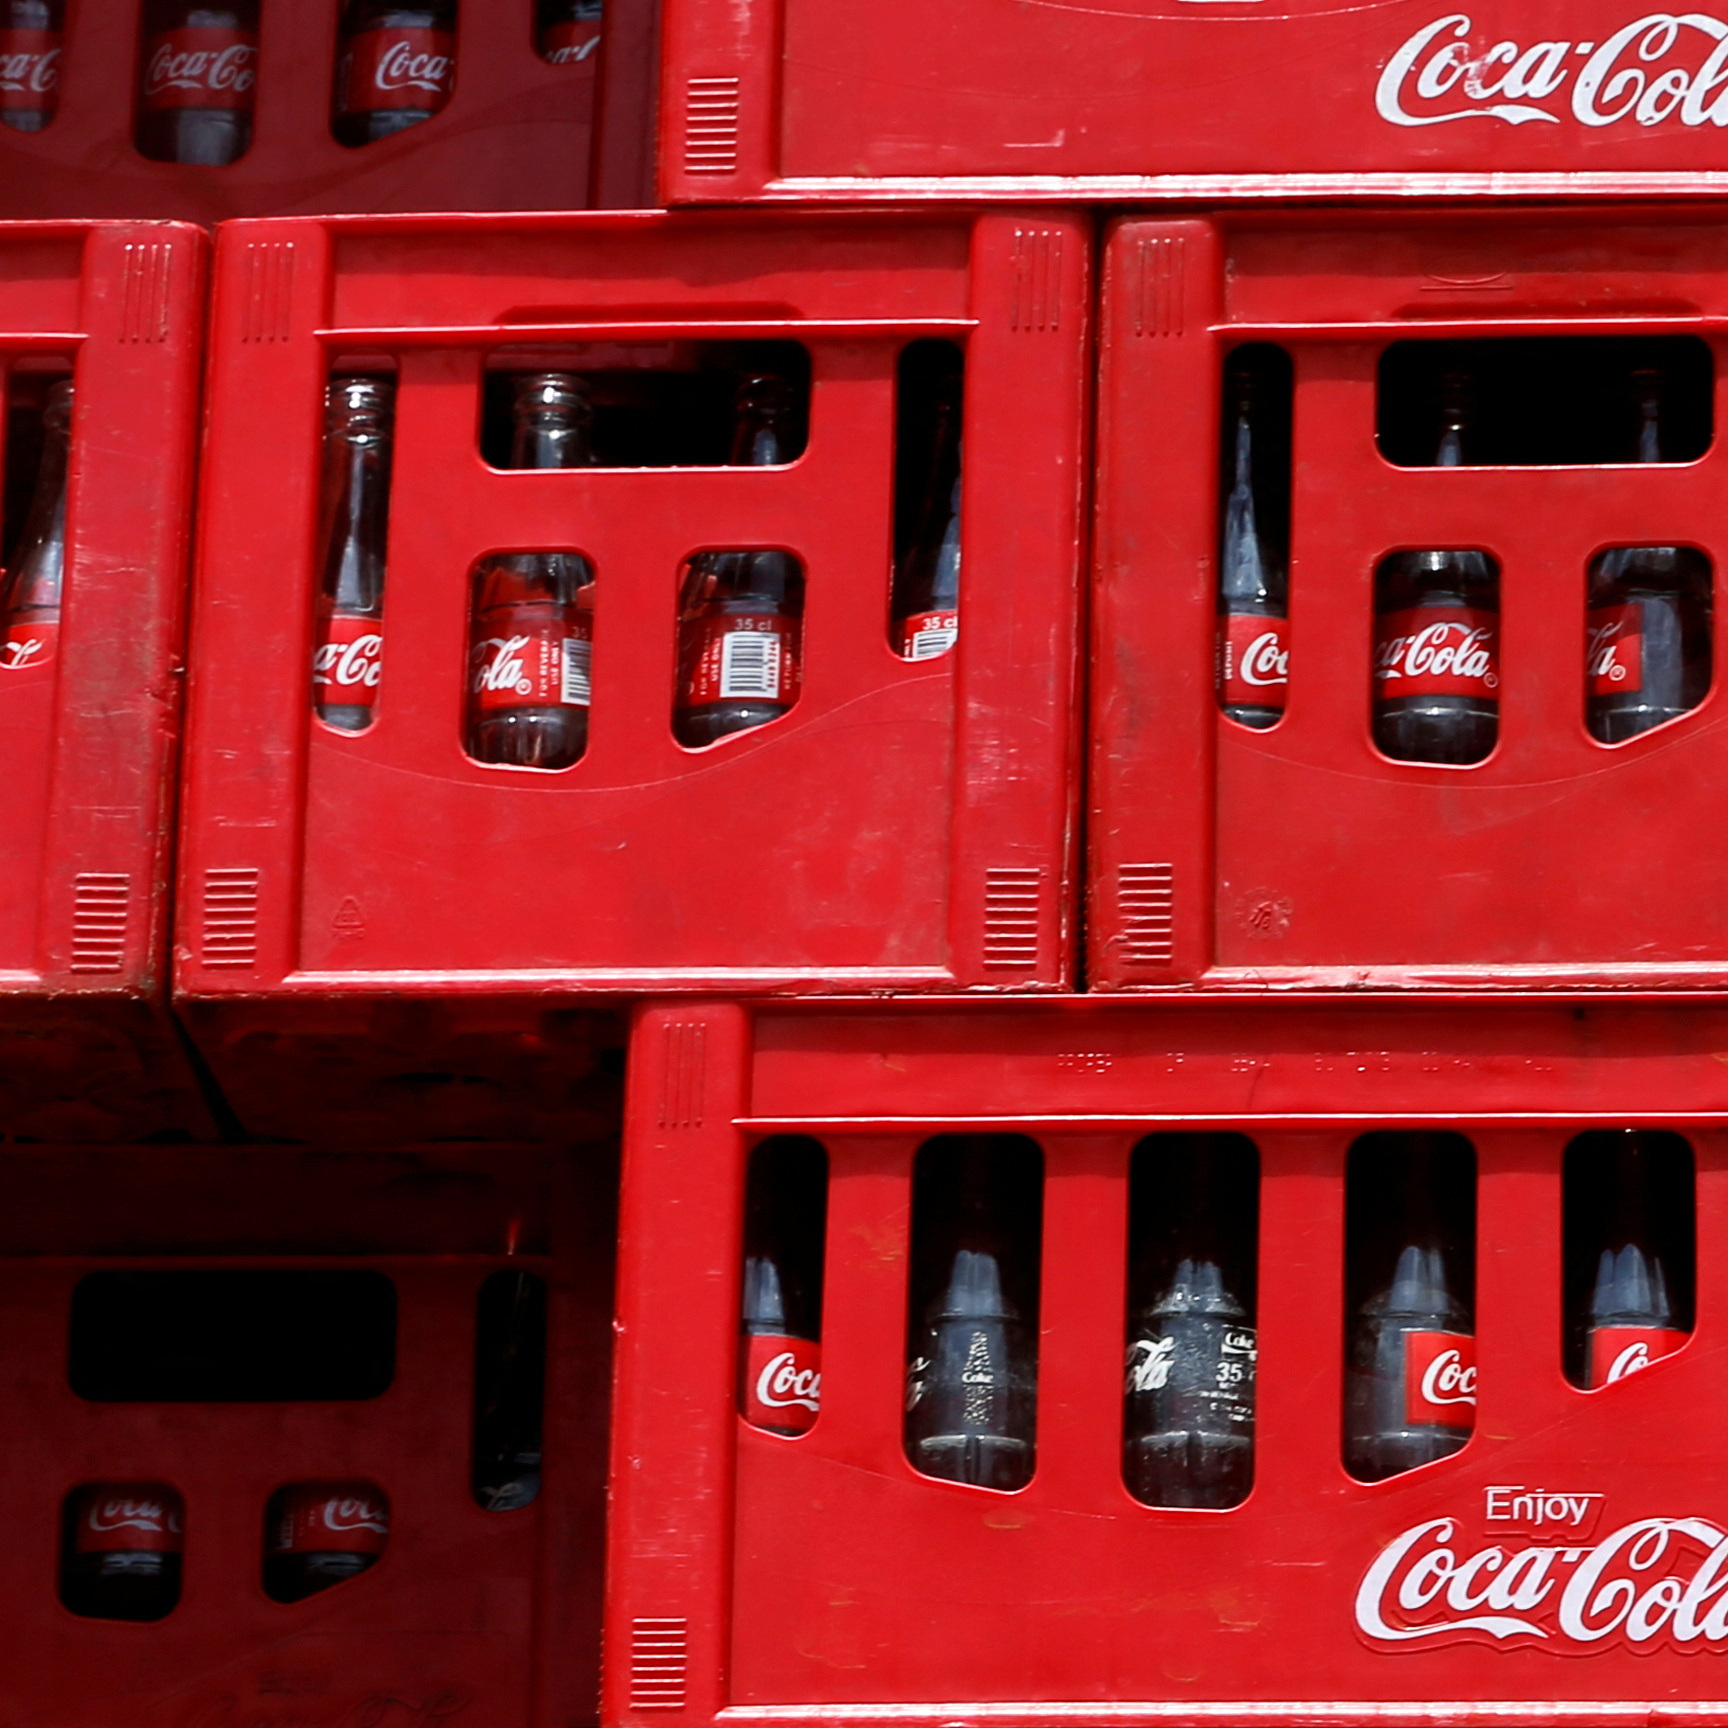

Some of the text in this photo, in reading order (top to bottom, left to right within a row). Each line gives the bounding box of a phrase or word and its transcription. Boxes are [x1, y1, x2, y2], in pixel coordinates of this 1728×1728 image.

[734, 618, 772, 631] 35 cl
[922, 616, 941, 631] 35
[1485, 1488, 1590, 1526] Enjoy
